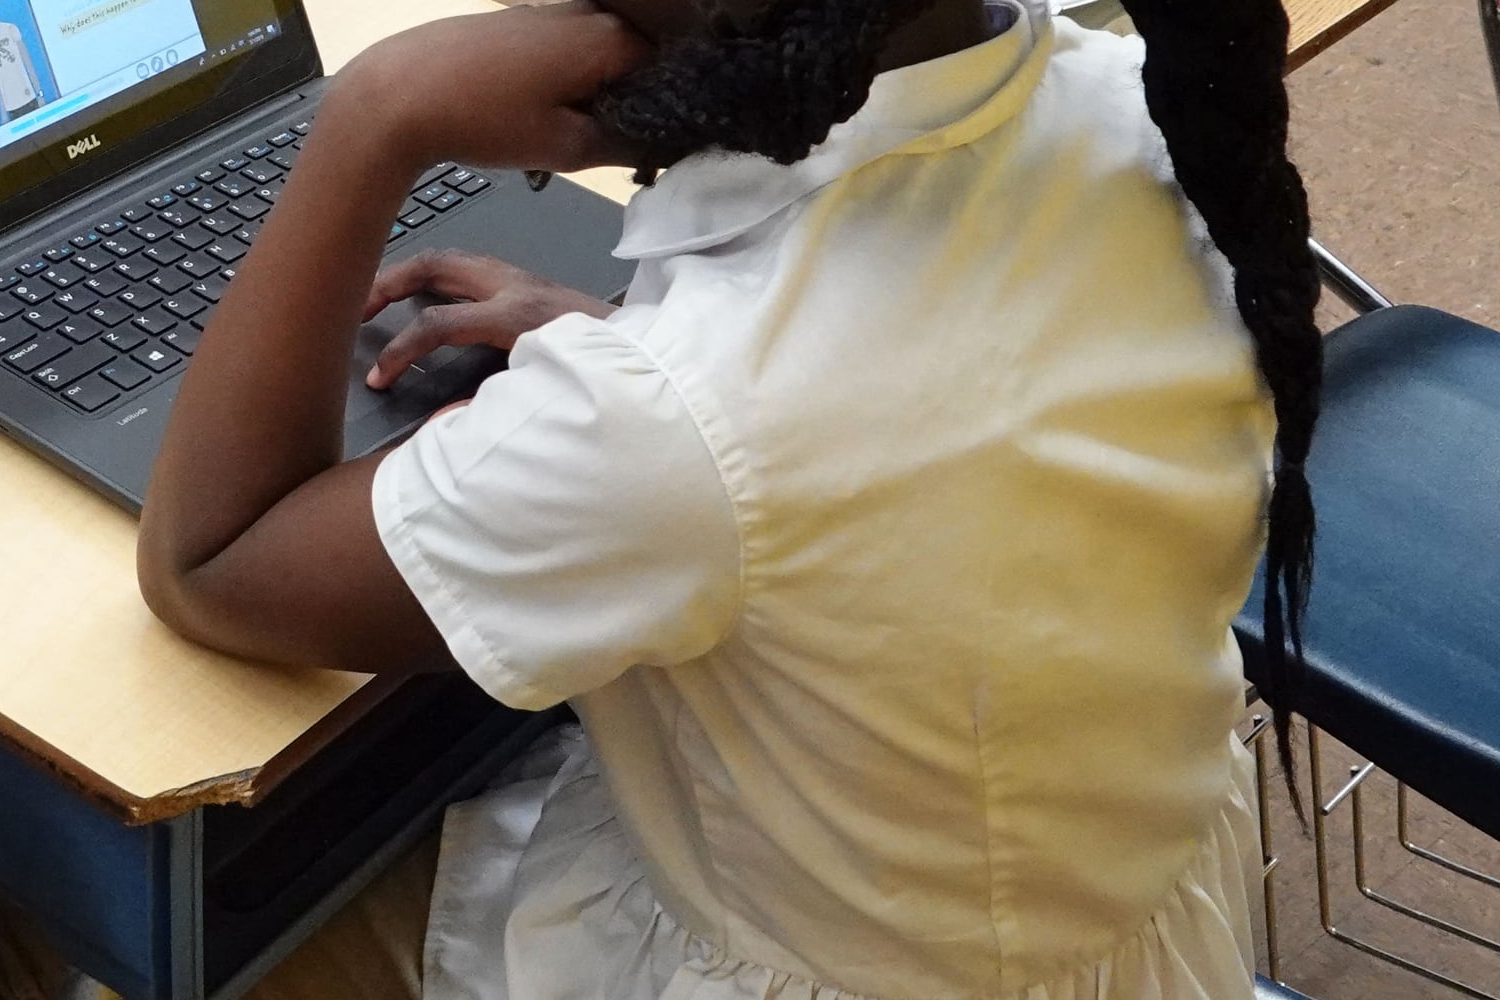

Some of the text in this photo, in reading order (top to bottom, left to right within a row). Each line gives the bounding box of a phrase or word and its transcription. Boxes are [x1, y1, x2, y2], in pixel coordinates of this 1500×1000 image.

[60, 21, 77, 35] Why
[77, 17, 92, 29] does
[92, 9, 106, 21] this
[106, 0, 129, 15] happen
[66, 133, 102, 160] DELL
[118, 263, 131, 271] R
[88, 279, 101, 288] E
[58, 292, 74, 303] W
[167, 300, 179, 309] C
[93, 308, 106, 317] S
[136, 316, 150, 325] X
[64, 324, 76, 333] A
[106, 332, 119, 341] Z
[116, 407, 149, 426] Latitude
